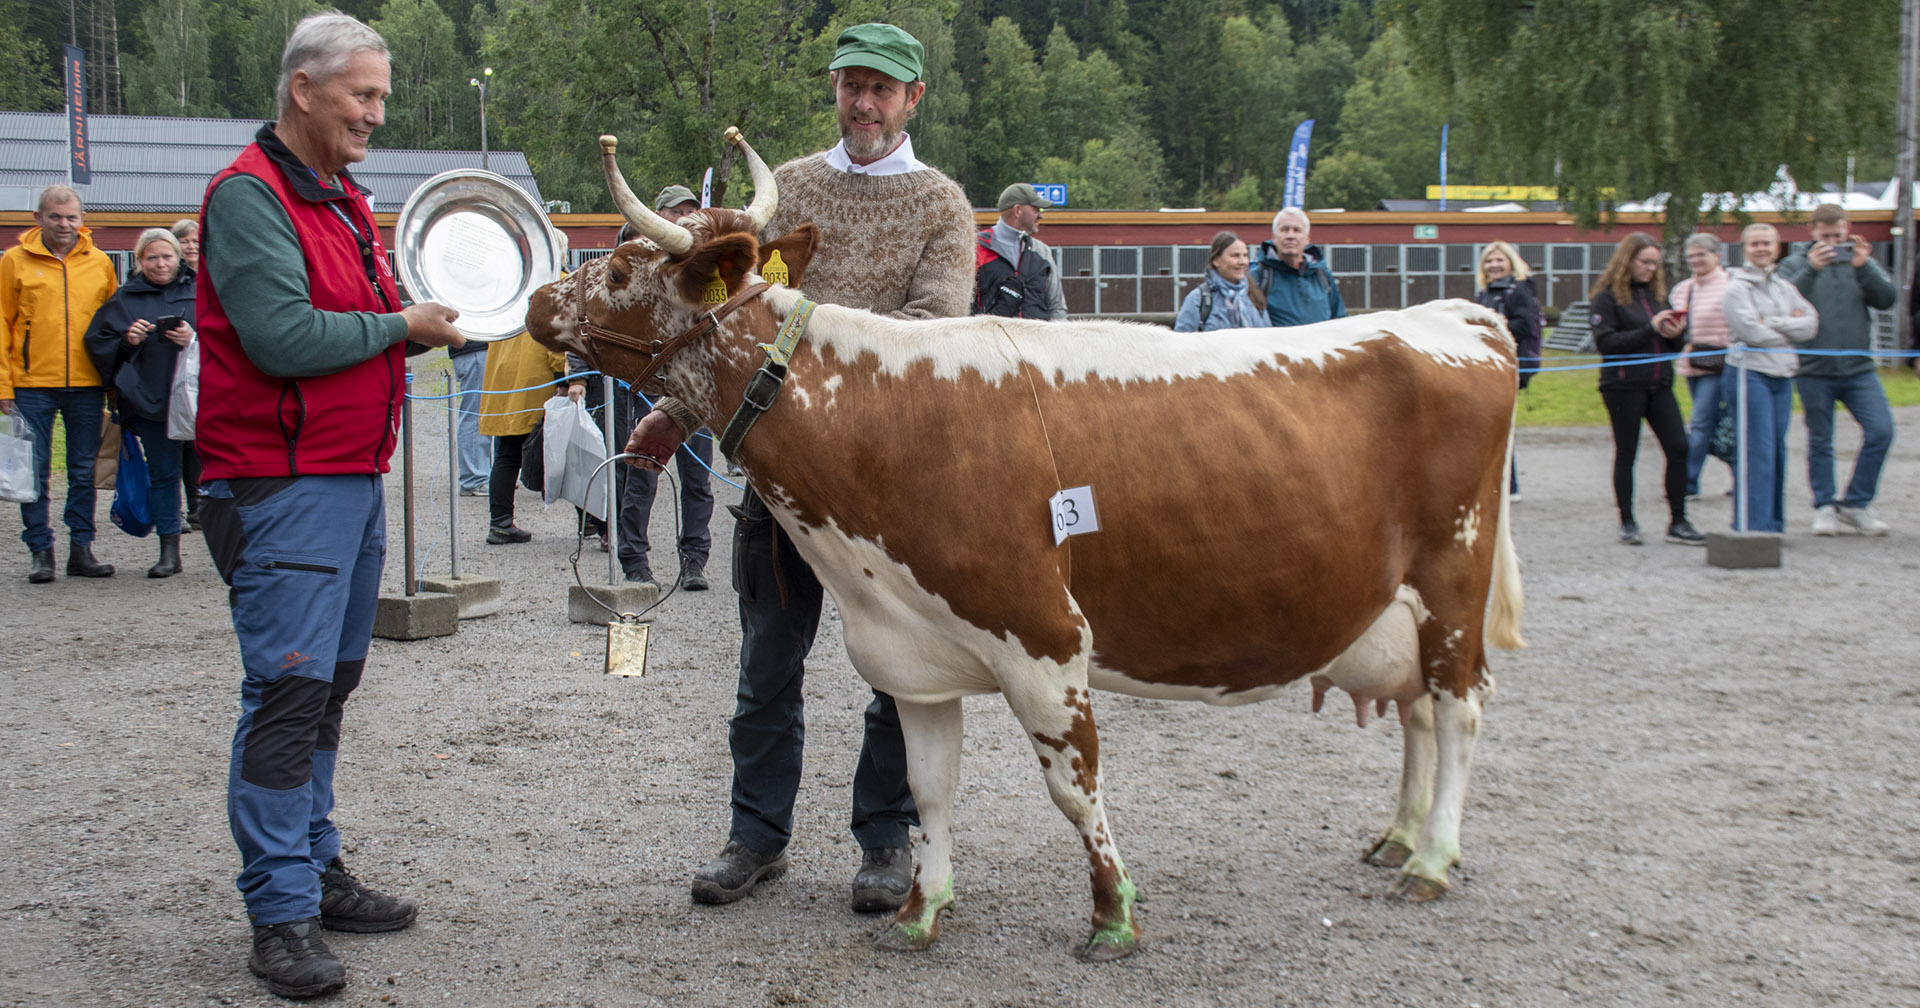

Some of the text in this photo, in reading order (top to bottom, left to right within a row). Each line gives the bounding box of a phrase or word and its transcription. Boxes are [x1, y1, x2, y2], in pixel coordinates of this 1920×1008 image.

[73, 60, 86, 172] JÄRNHEIMR
[763, 272, 788, 285] 0035
[703, 288, 727, 303] 0035
[1056, 498, 1080, 531] 63
